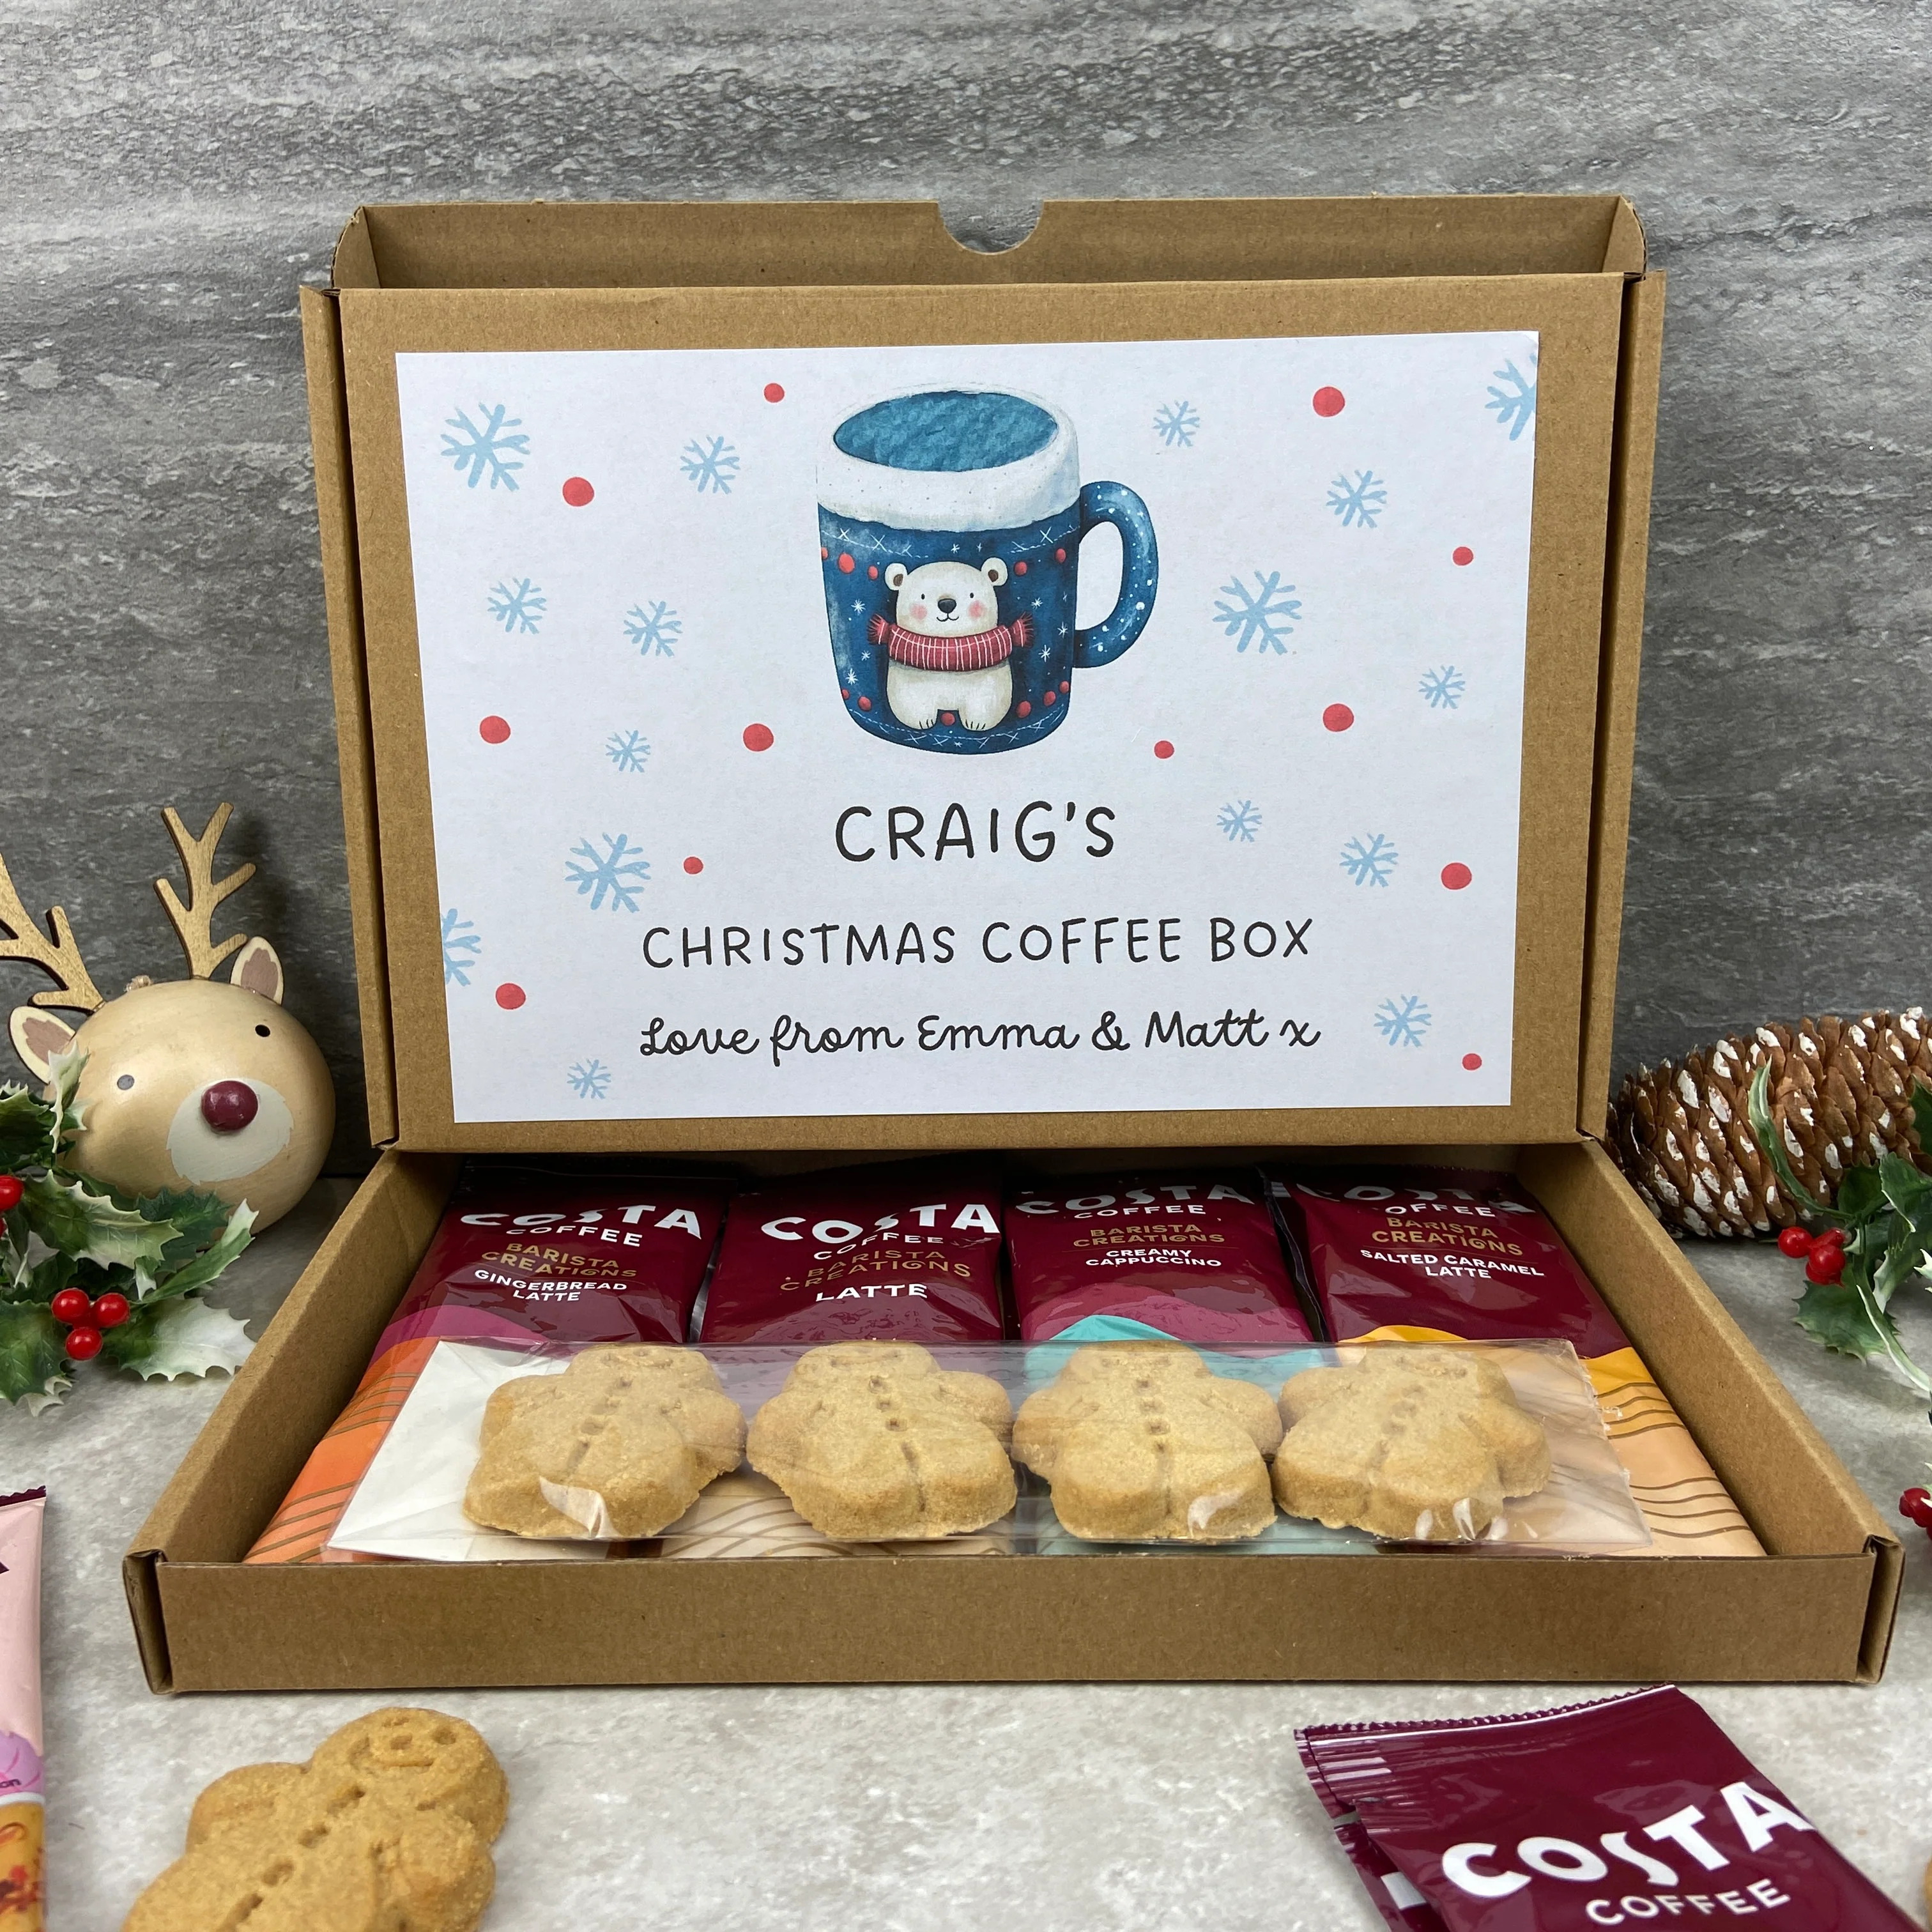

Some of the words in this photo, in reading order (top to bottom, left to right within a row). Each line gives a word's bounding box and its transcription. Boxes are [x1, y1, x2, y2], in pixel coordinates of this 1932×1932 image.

[836, 801, 1116, 862] CRAIG'S
[643, 921, 955, 969] CHRISTMAS
[982, 917, 1181, 964] COFFEE
[1209, 917, 1313, 962] BOX
[640, 1017, 760, 1056] Love
[769, 1015, 905, 1067] from
[917, 1015, 1080, 1051] Emma
[1091, 1011, 1131, 1051] &
[1144, 1008, 1269, 1048] Matt
[1279, 1019, 1321, 1048] x
[1016, 1184, 1255, 1214] COSTA
[1074, 1205, 1206, 1218] COFFEE
[1385, 1203, 1496, 1217] OFFEE
[461, 1205, 702, 1239] COSTA
[761, 1204, 1000, 1244] COSTA
[1091, 1224, 1202, 1237] BARISTA
[1386, 1217, 1498, 1239] BARISTA
[506, 1225, 643, 1246] COFFEE
[813, 1232, 944, 1260] COFFEE
[1073, 1234, 1225, 1247] CREATIONS
[1372, 1230, 1523, 1256] CREATIONS
[481, 1252, 637, 1278] CREATIONS
[506, 1243, 620, 1268] BARISTA
[808, 1250, 946, 1277] BARISTA
[1085, 1256, 1222, 1267] CAPPUCCINO
[1106, 1248, 1192, 1257] CREAMY
[1360, 1250, 1438, 1265] SALTED
[1443, 1255, 1544, 1276] CARAMEL
[475, 1269, 627, 1291] GINGERBREAD
[780, 1261, 970, 1291] CREATIONS
[1425, 1266, 1492, 1279] LATTE
[513, 1290, 580, 1301] LATTE
[815, 1284, 928, 1301] LATTE
[1441, 1781, 1816, 1899] COSTA
[1585, 1878, 1790, 1926] COFFEE
